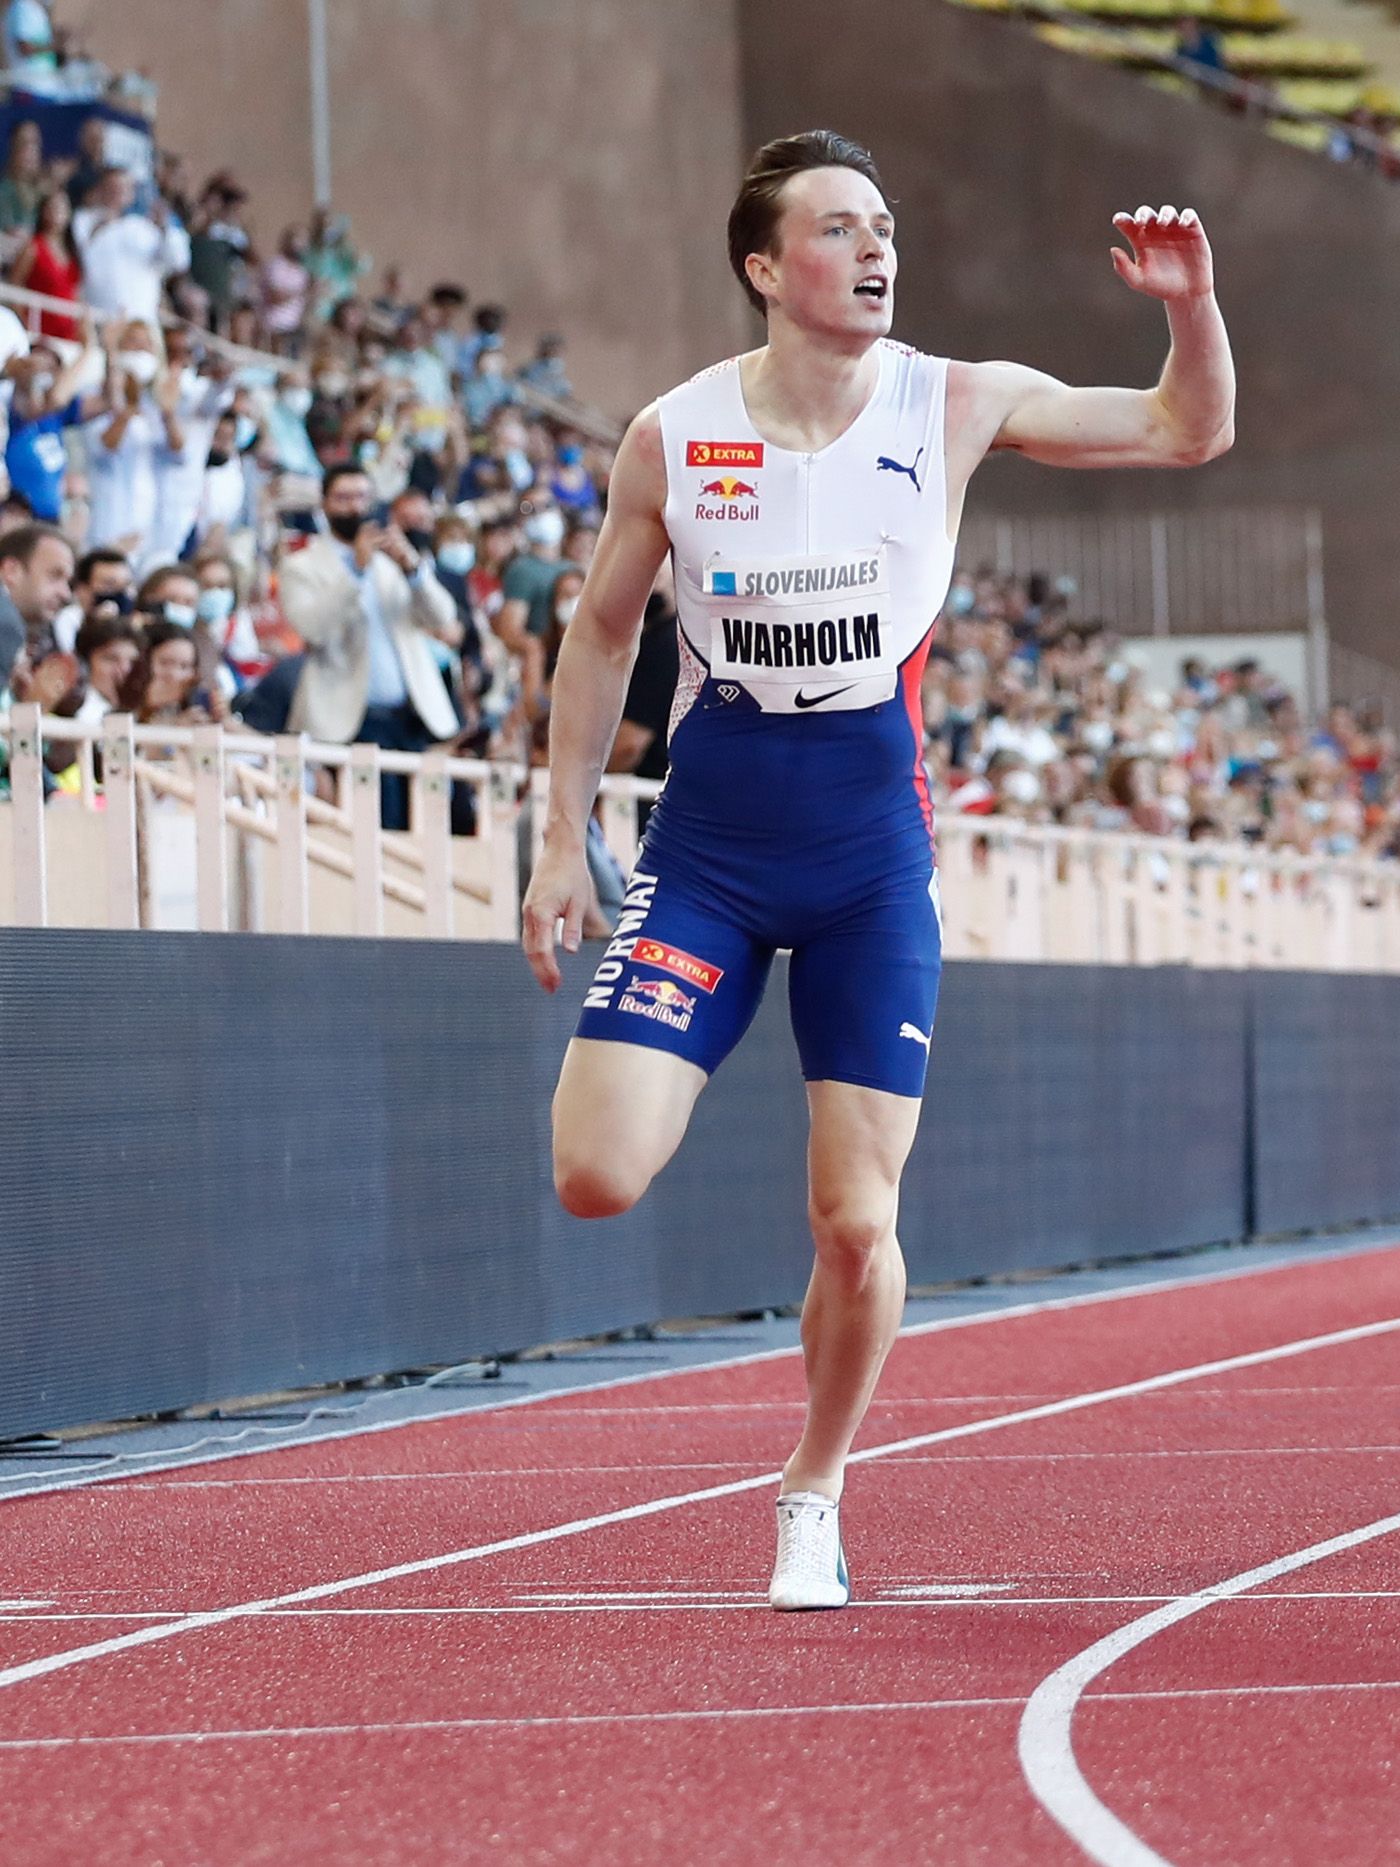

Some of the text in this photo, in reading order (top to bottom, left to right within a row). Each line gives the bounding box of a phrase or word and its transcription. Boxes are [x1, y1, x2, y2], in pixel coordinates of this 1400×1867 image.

[713, 448, 756, 461] EXTRA
[695, 504, 759, 521] Red Bull
[745, 560, 879, 596] SLOVENIJALES
[722, 613, 881, 667] WARHOLM
[583, 871, 658, 1009] NORWAY
[667, 954, 709, 983] EXTRA
[618, 994, 691, 1032] Red Bull
